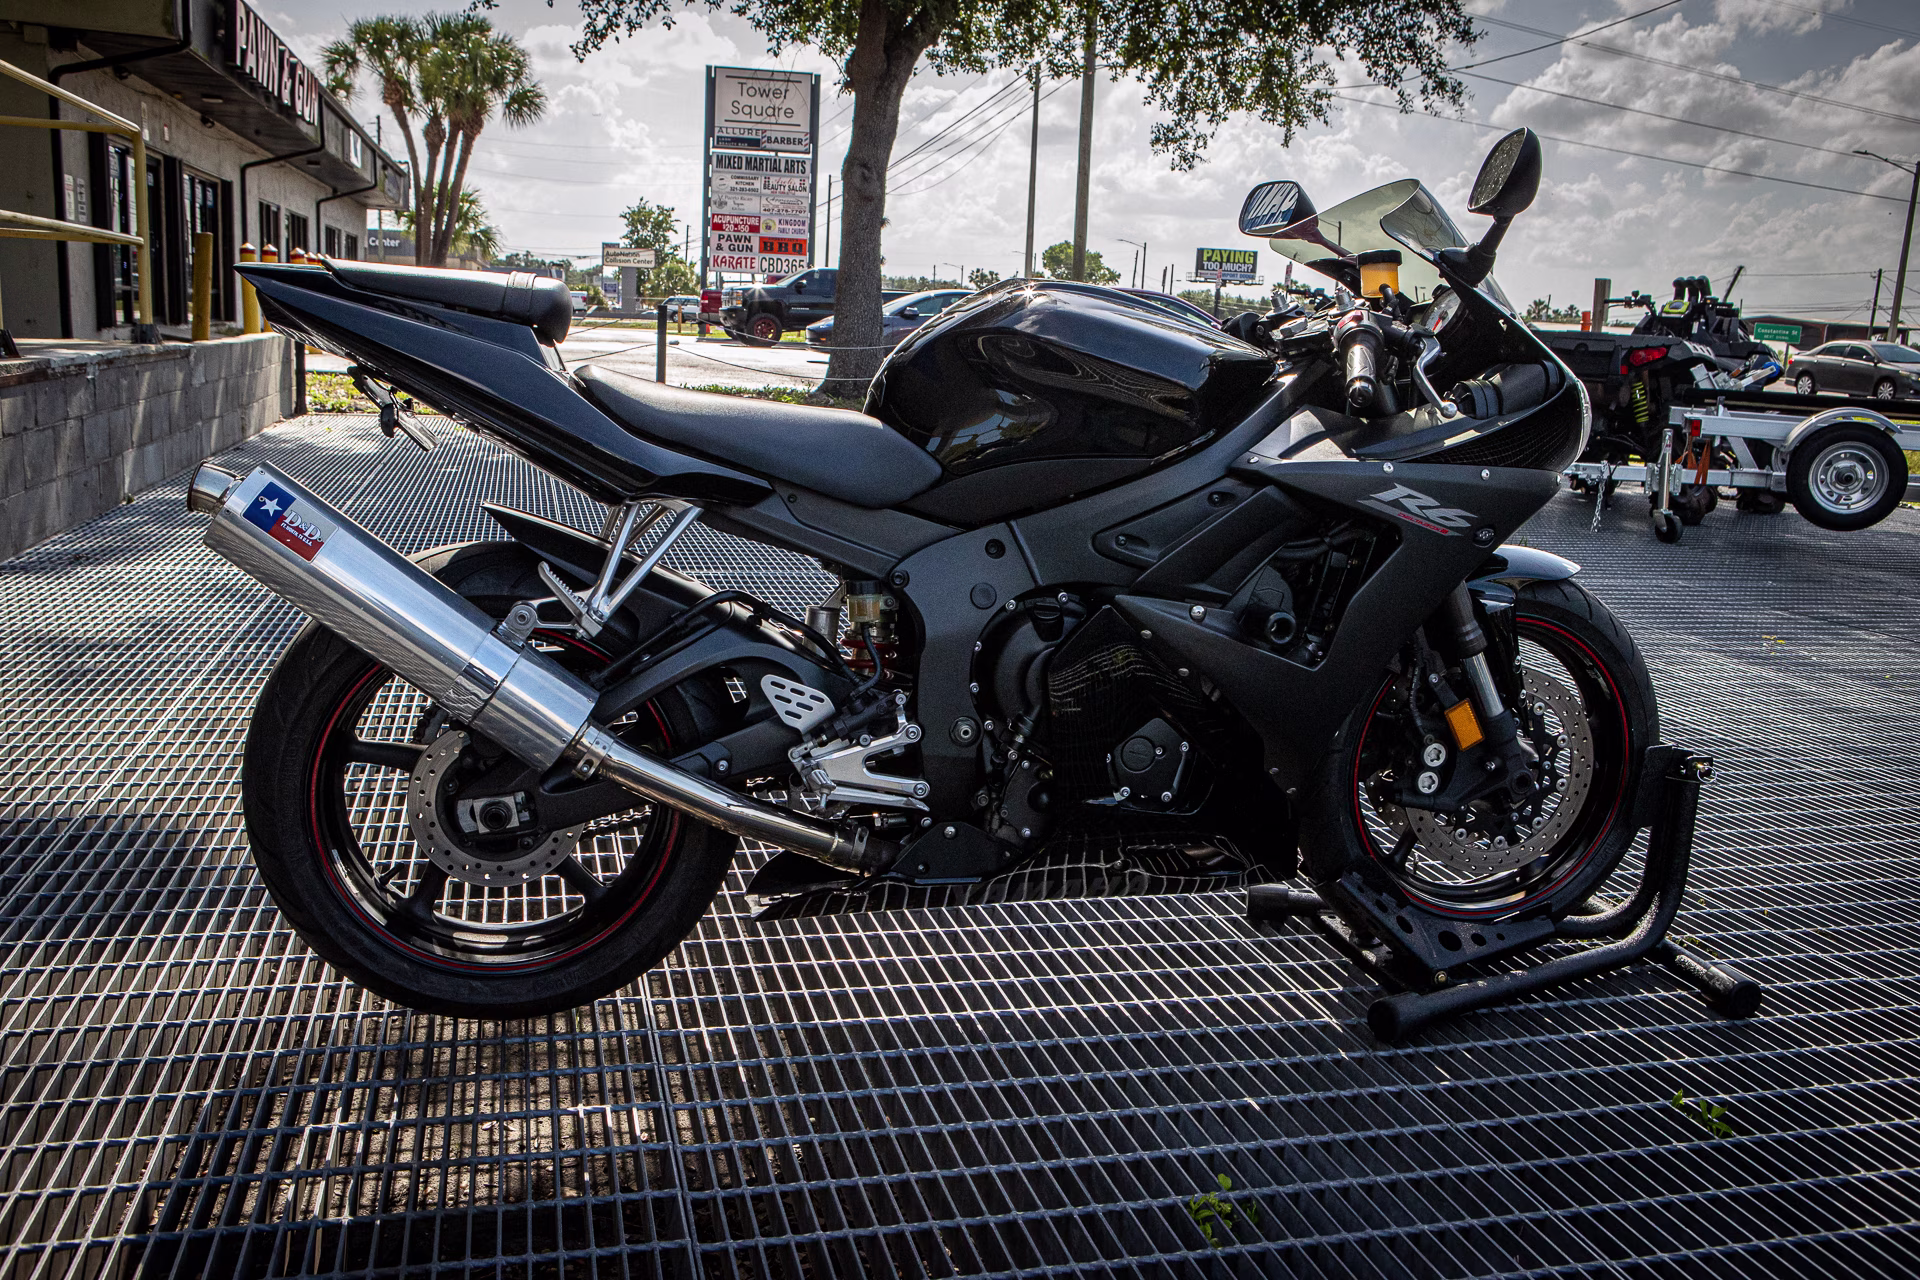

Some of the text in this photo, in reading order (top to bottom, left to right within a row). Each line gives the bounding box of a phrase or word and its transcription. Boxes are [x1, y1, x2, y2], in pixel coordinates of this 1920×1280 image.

[236, 0, 319, 126] PAWN & GUN
[737, 81, 789, 99] Tower
[731, 100, 794, 119] Square
[717, 126, 761, 136] ALLURE
[766, 136, 804, 146] BARBER
[715, 154, 806, 175] MIXED MARTIAL ARTS
[763, 183, 807, 193] BEAUTY SALON
[713, 215, 760, 226] ACUPUNCTURE
[778, 218, 806, 227] KINGDOM
[717, 234, 752, 244] PAWN
[715, 243, 753, 253] & GUN
[763, 241, 803, 254] BBQ
[605, 250, 641, 258] AutoNation
[1203, 249, 1254, 264] PAYING
[713, 255, 756, 270] KARATE
[760, 256, 805, 274] CBD365
[1203, 261, 1220, 270] TOO
[1222, 262, 1253, 273] MUCH?
[1757, 327, 1789, 335] Constantine
[1369, 482, 1478, 527] R6
[283, 509, 321, 540] D&D
